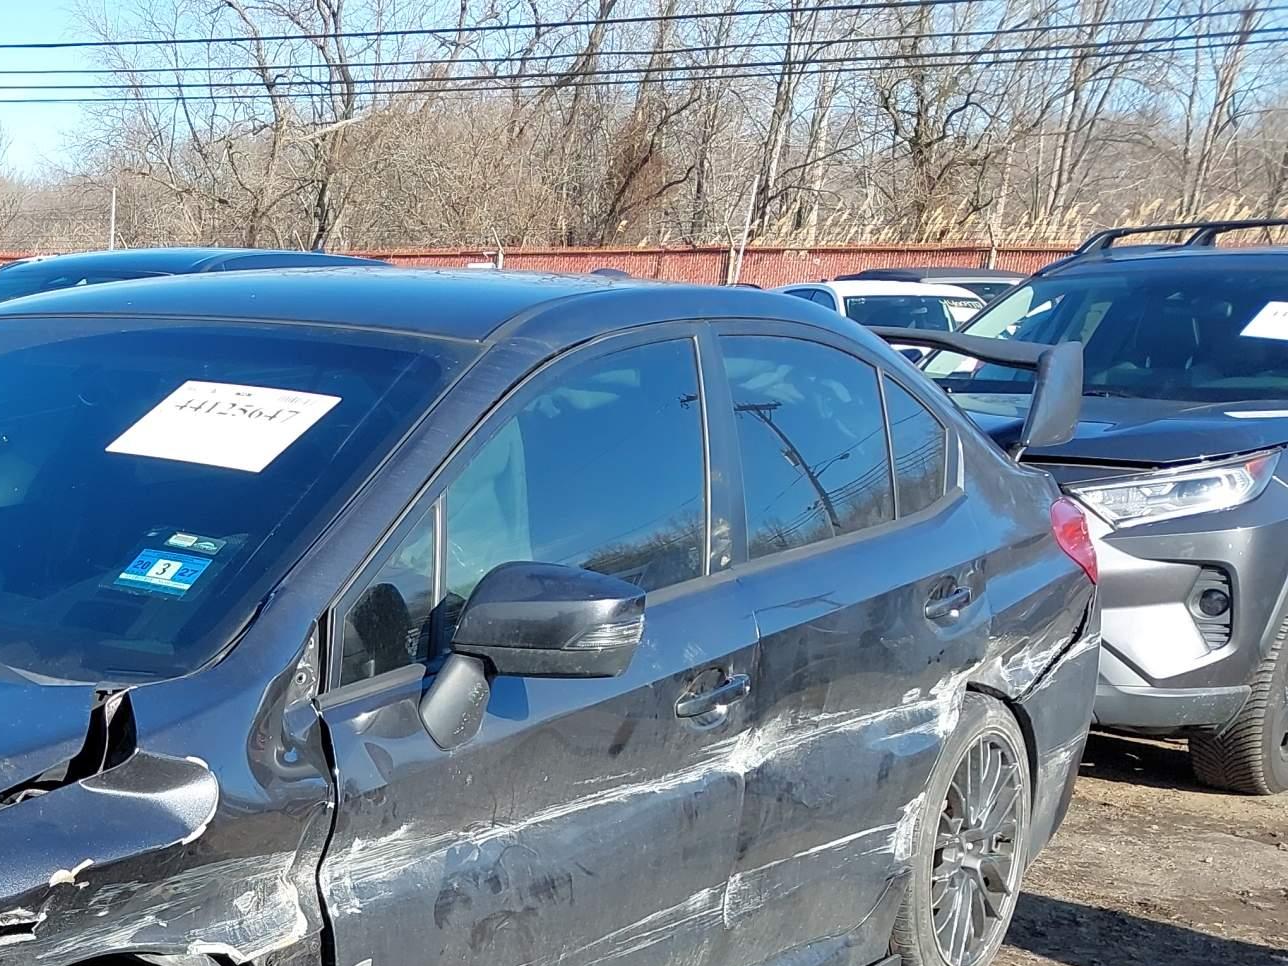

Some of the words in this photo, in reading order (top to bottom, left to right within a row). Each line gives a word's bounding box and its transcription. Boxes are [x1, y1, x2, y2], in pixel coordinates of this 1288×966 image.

[176, 398, 300, 424] 44125647
[132, 559, 152, 571] 20
[155, 562, 172, 576] 3
[177, 567, 200, 579] 27
